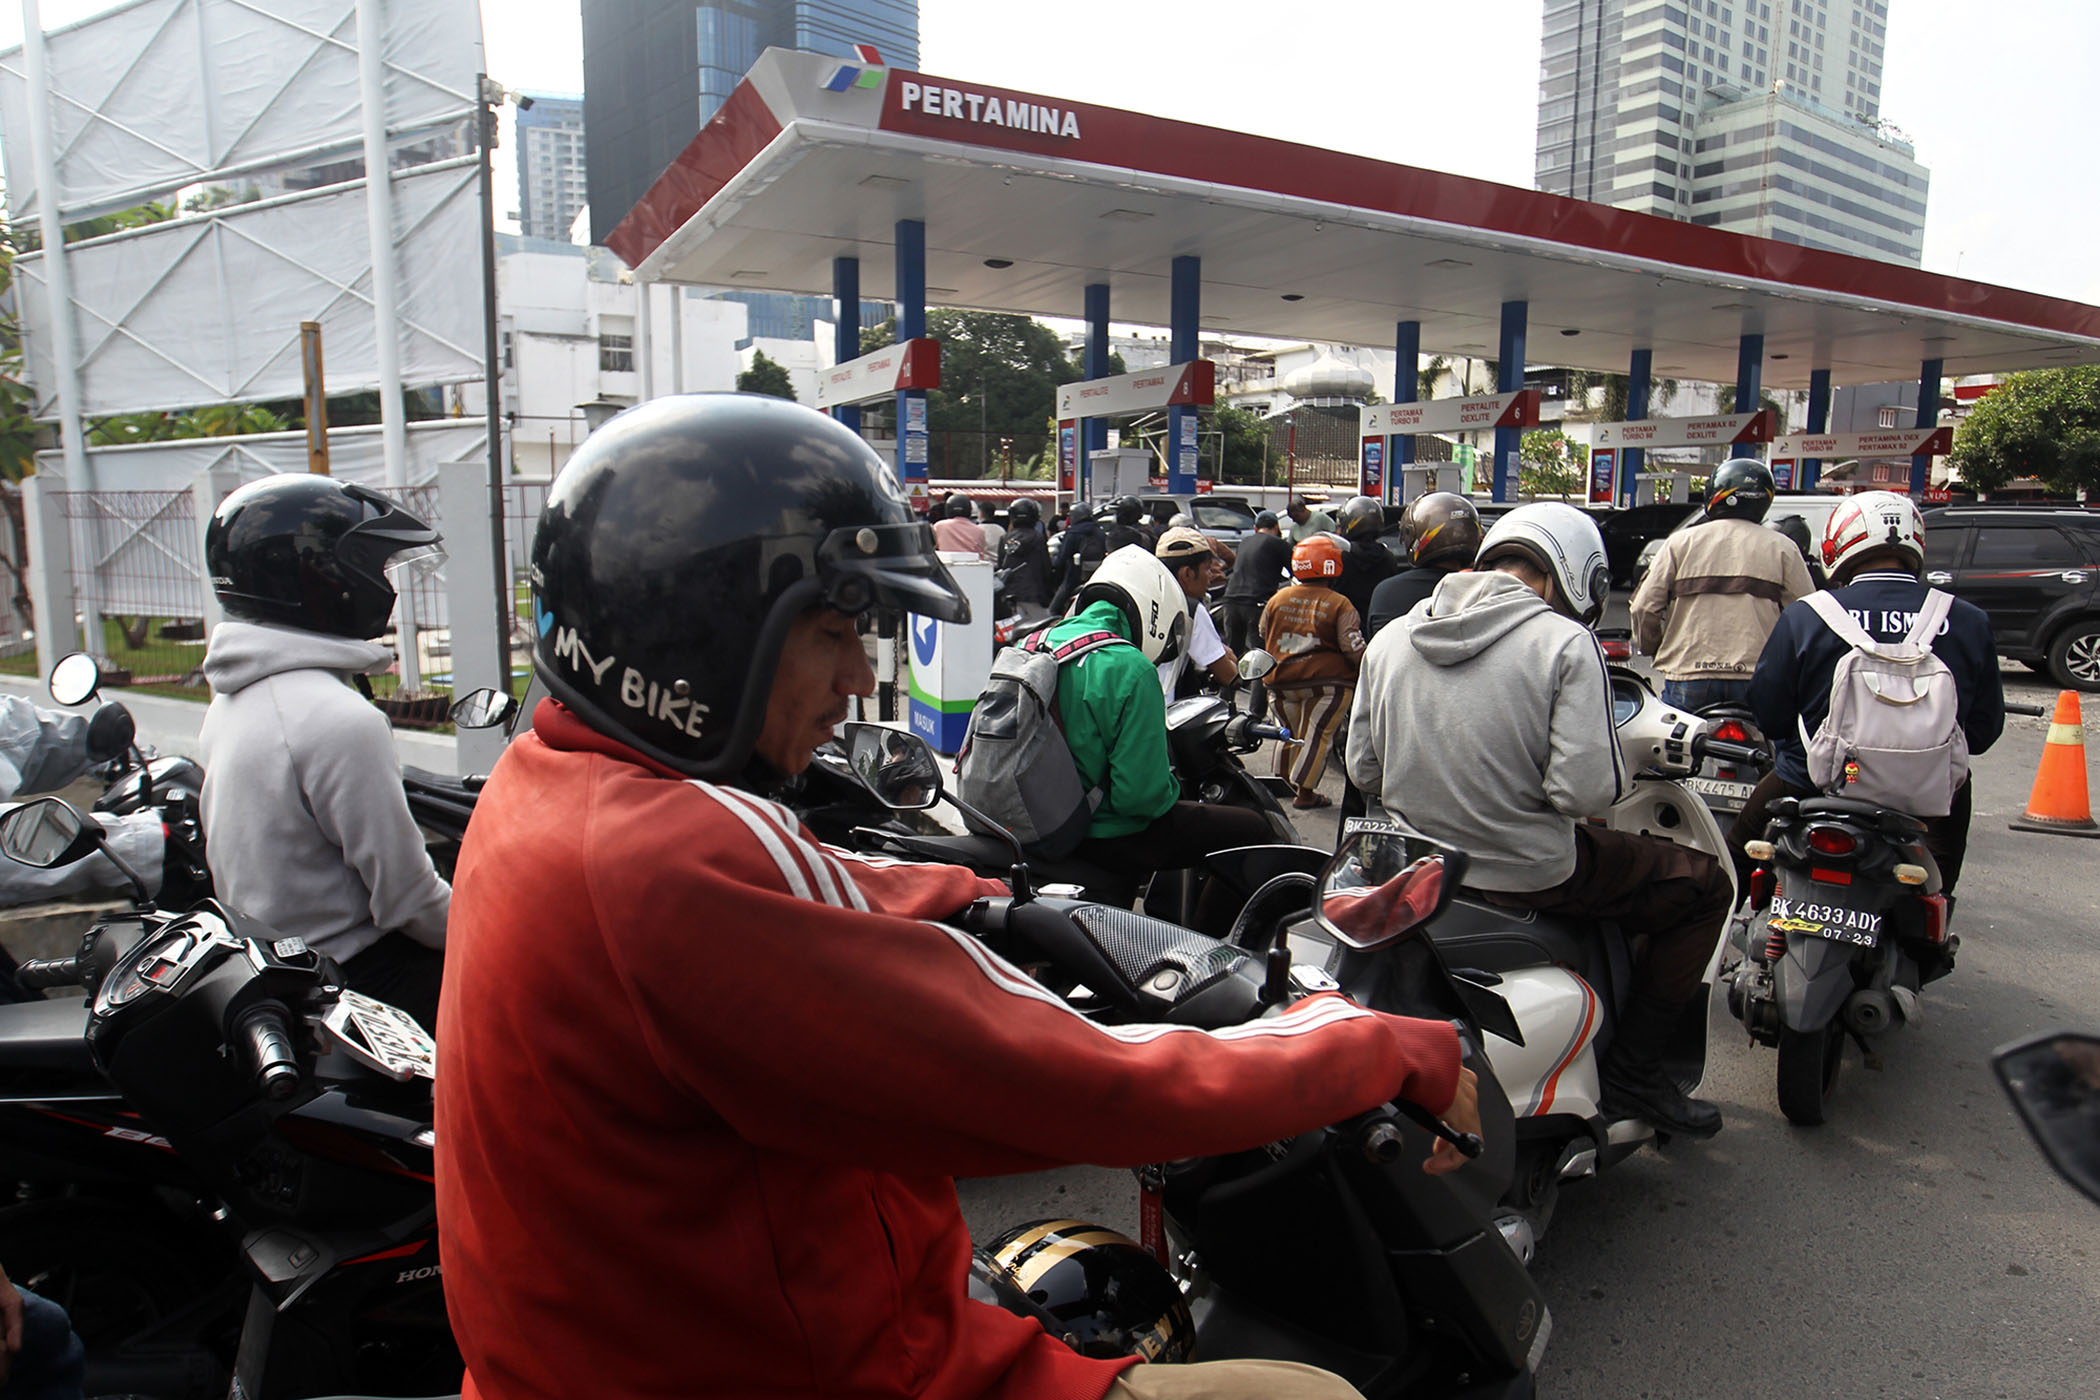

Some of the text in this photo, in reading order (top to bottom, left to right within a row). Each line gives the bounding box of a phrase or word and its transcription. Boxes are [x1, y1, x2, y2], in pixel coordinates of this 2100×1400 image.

[901, 81, 1081, 139] PERTAMINA
[1133, 376, 1165, 389] PERTAMAX
[1460, 400, 1500, 413] PERTALITE
[1390, 408, 1424, 418] PERTAMAX
[1460, 412, 1491, 423] DEXLITE
[1514, 407, 1521, 419] 6
[1391, 417, 1412, 426] TURBO
[1687, 421, 1726, 430] PERTAMAX
[1622, 424, 1657, 433] PERTAMAX
[1751, 425, 1759, 436] 4
[1622, 432, 1645, 441] TURBO
[1686, 431, 1717, 440] DEXLITE
[1858, 433, 1920, 443] PERTAMINA DEX
[1802, 439, 1837, 447] PERTAMAX
[1858, 442, 1897, 451] PERTAMAX
[1933, 440, 1940, 449] 2
[1935, 492, 1948, 500] LPG
[554, 625, 710, 738] MY BIKE
[914, 711, 935, 736] MASUK
[1703, 782, 1736, 797] 4475
[1771, 897, 1792, 916] BK
[1795, 902, 1844, 924] 4633
[1845, 910, 1882, 932] ADY
[395, 1264, 443, 1284] HON
